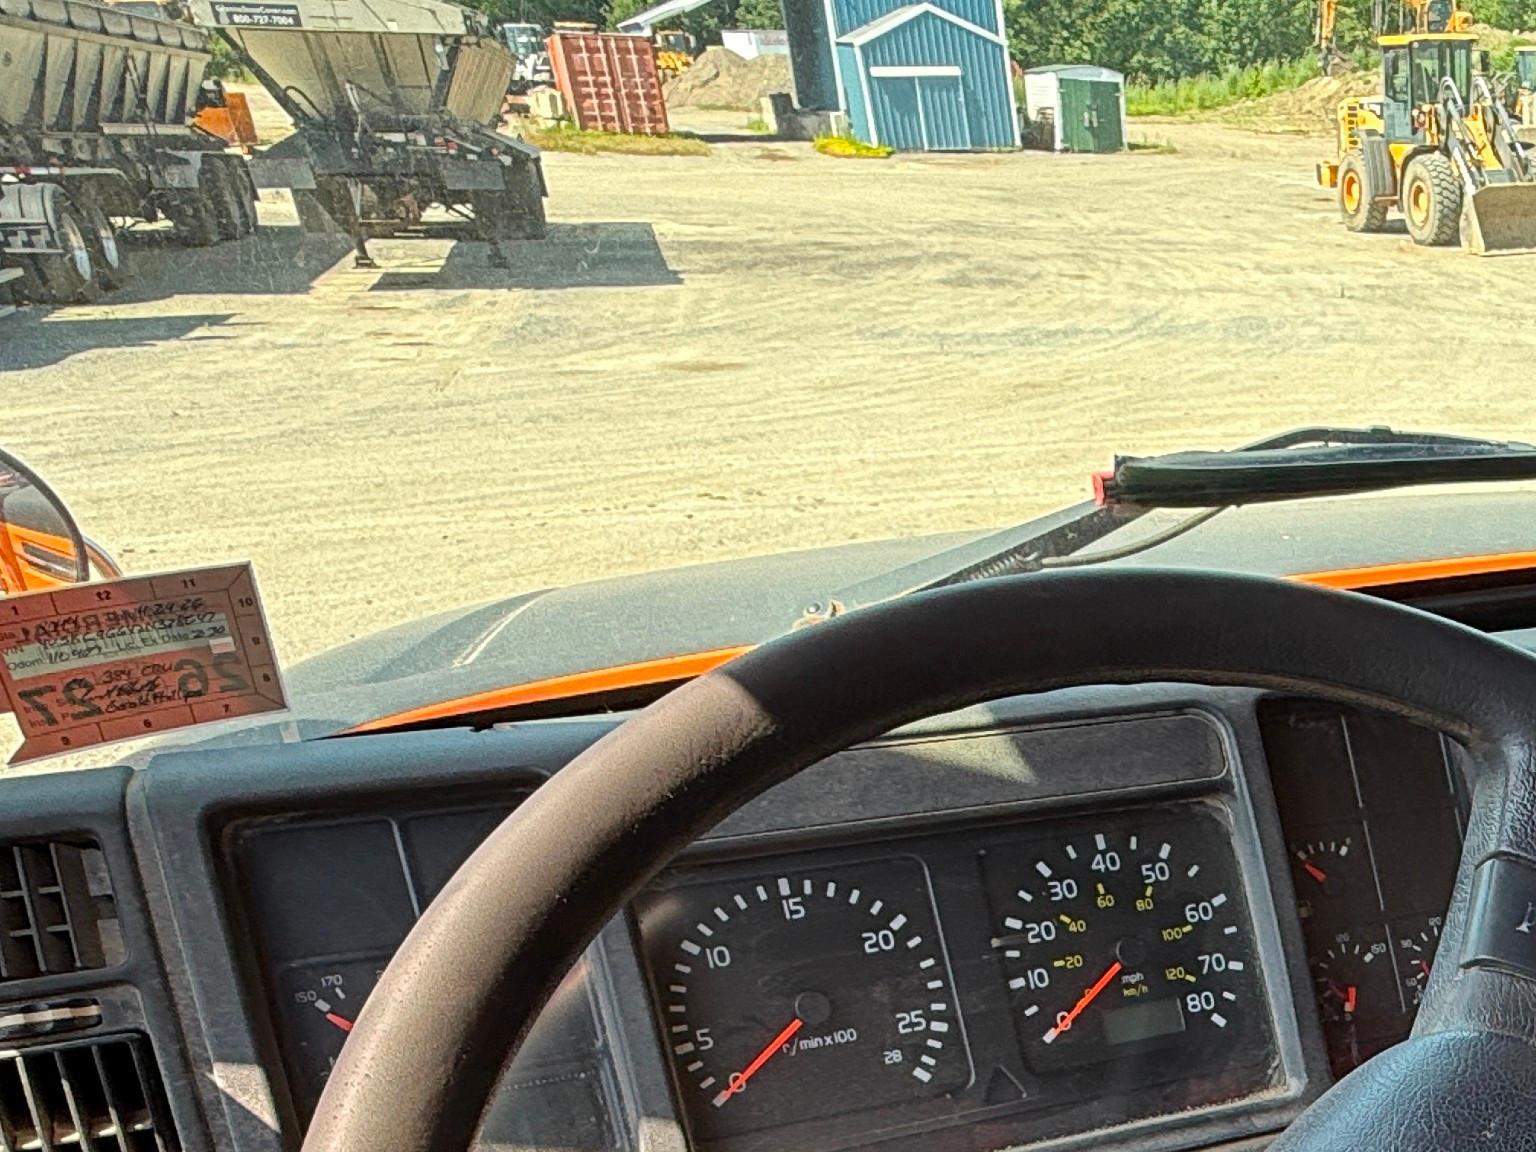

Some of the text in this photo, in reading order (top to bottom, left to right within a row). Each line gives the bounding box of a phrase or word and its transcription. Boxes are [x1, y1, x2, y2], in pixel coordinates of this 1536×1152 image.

[238, 597, 254, 608] 10
[1091, 851, 1121, 873] 40
[1141, 861, 1170, 884] 50
[1048, 879, 1078, 901] 30
[782, 897, 805, 921] 15
[1097, 895, 1115, 908] 60
[1136, 898, 1153, 911] 80
[1185, 901, 1213, 923] 60
[1025, 921, 1056, 944] 20
[1068, 920, 1086, 933] 40
[1162, 928, 1182, 941] 100
[861, 929, 895, 953] 20
[705, 946, 731, 969] 10
[1065, 955, 1083, 968] 20
[1198, 953, 1226, 975] 70
[321, 974, 343, 988] 170
[1027, 968, 1049, 990] 10
[1122, 972, 1144, 984] mph
[1165, 967, 1185, 980] 120
[1186, 991, 1215, 1013] 80
[895, 1010, 926, 1034] 25
[695, 1028, 714, 1050] 5
[883, 1049, 902, 1065] 28
